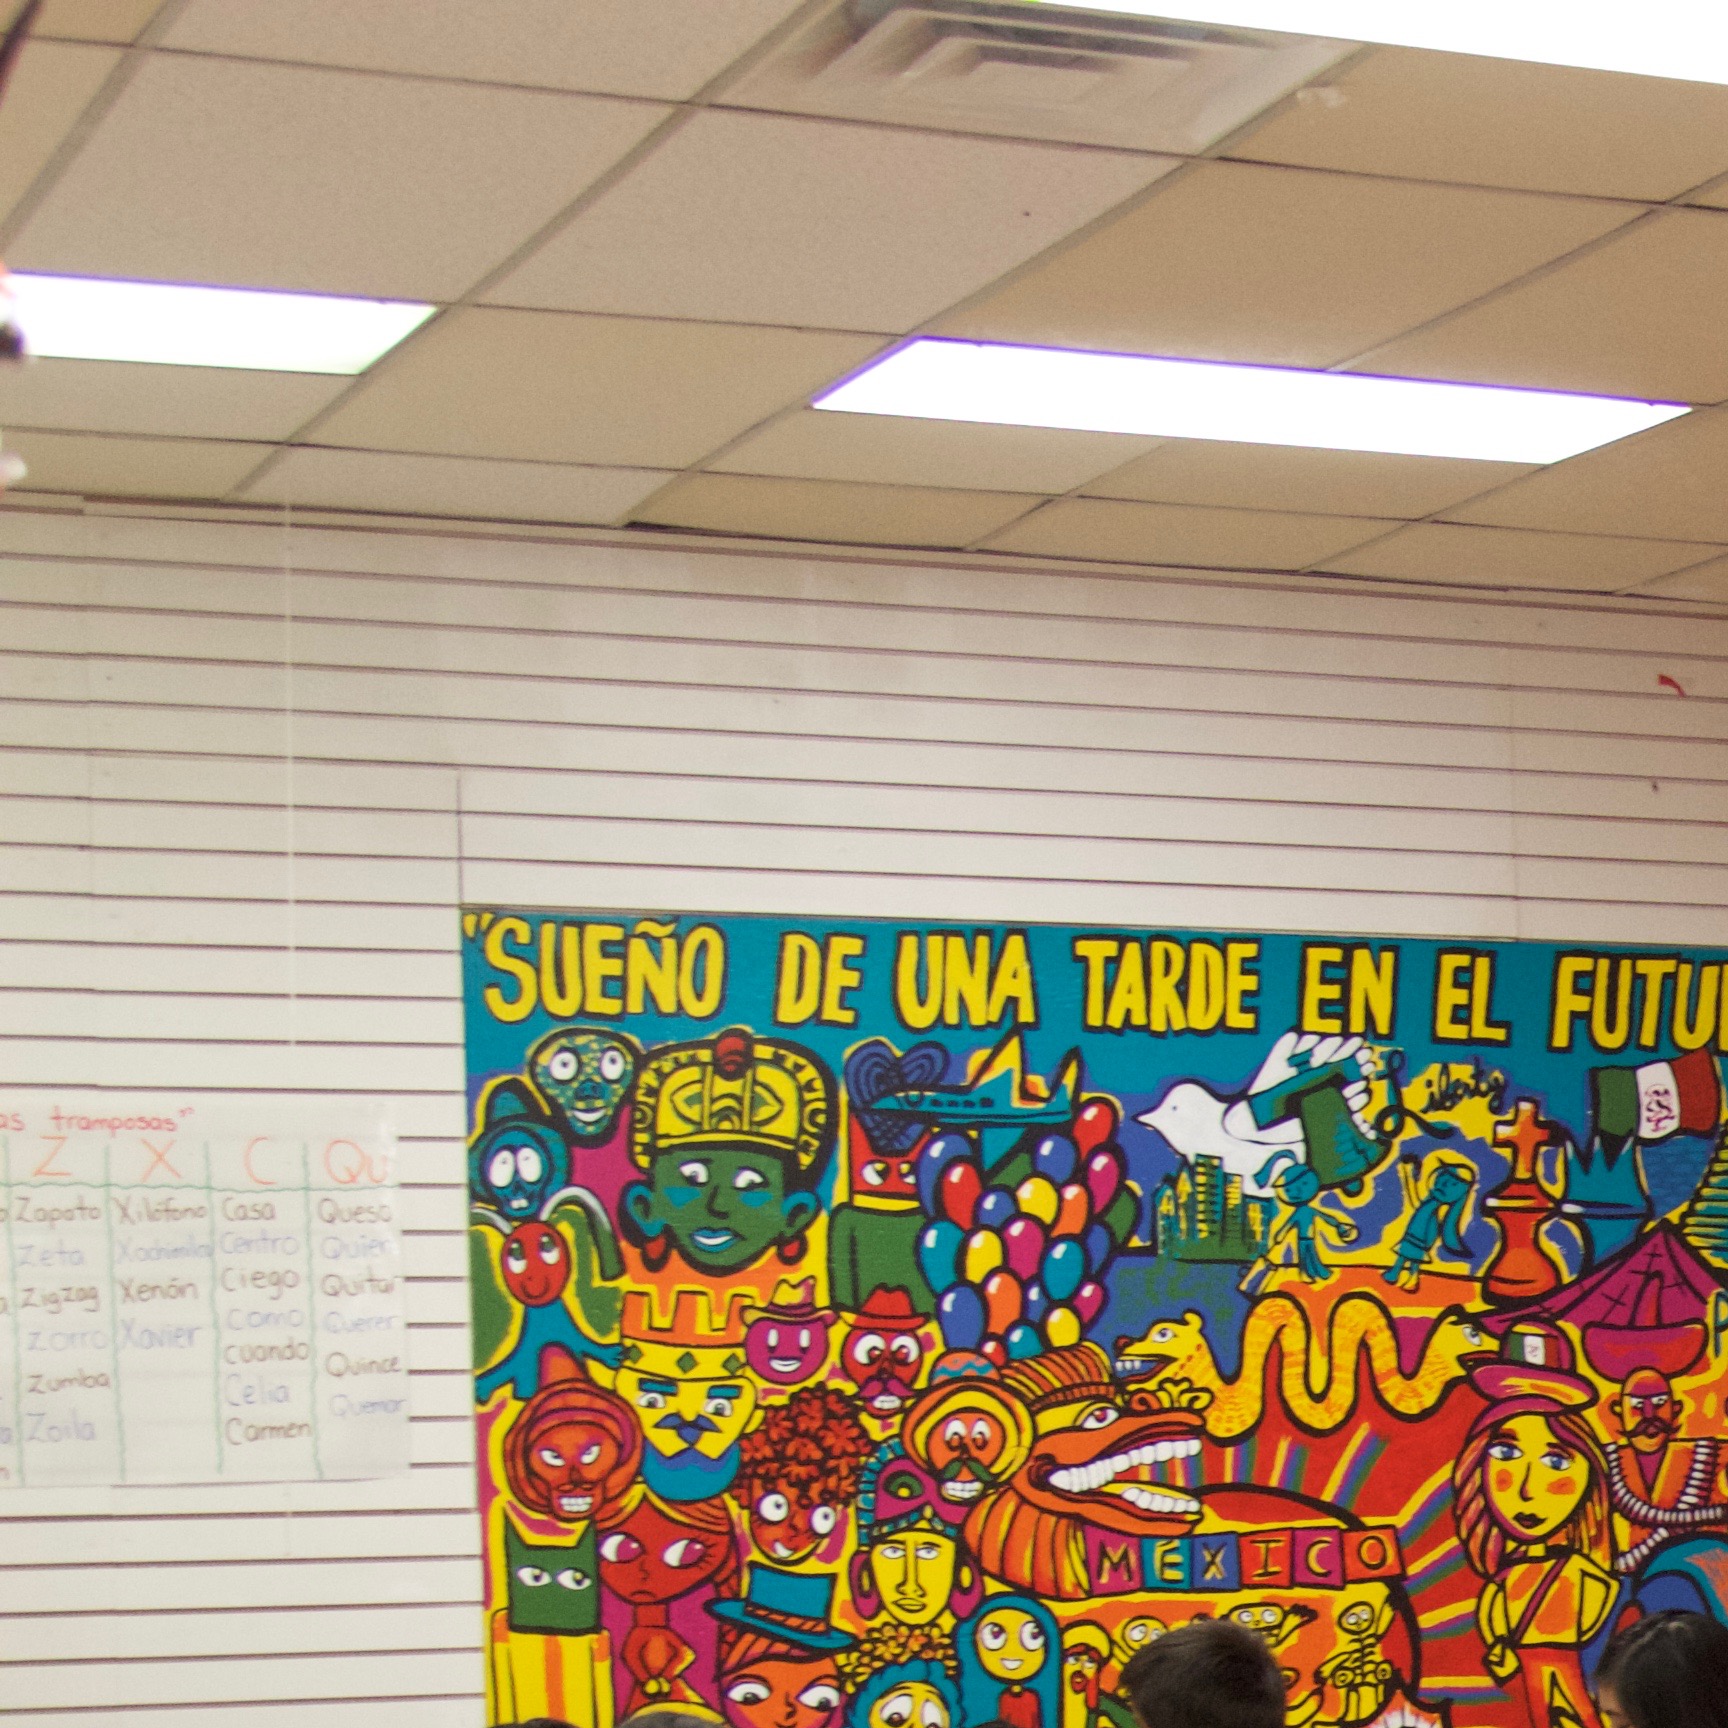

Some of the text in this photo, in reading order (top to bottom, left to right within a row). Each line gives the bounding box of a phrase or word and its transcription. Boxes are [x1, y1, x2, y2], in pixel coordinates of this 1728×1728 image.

[463, 912, 726, 1022] "SUEÑO
[776, 932, 863, 1025] DE
[898, 934, 1036, 1030] UNA
[1074, 938, 1258, 1034] TARDE
[1303, 946, 1395, 1035] EN
[1434, 953, 1506, 1041] EL
[33, 1135, 72, 1177] Z
[140, 1138, 182, 1183] X
[244, 1136, 277, 1185] C
[324, 1139, 388, 1184] Qu
[15, 1195, 102, 1228] Zapato
[221, 1197, 275, 1222] Casa
[317, 1198, 392, 1224] Queso
[17, 1238, 84, 1267] Zeta
[220, 1230, 299, 1255] Centro
[221, 1267, 301, 1300] Ciego
[225, 1417, 313, 1446] Carmen
